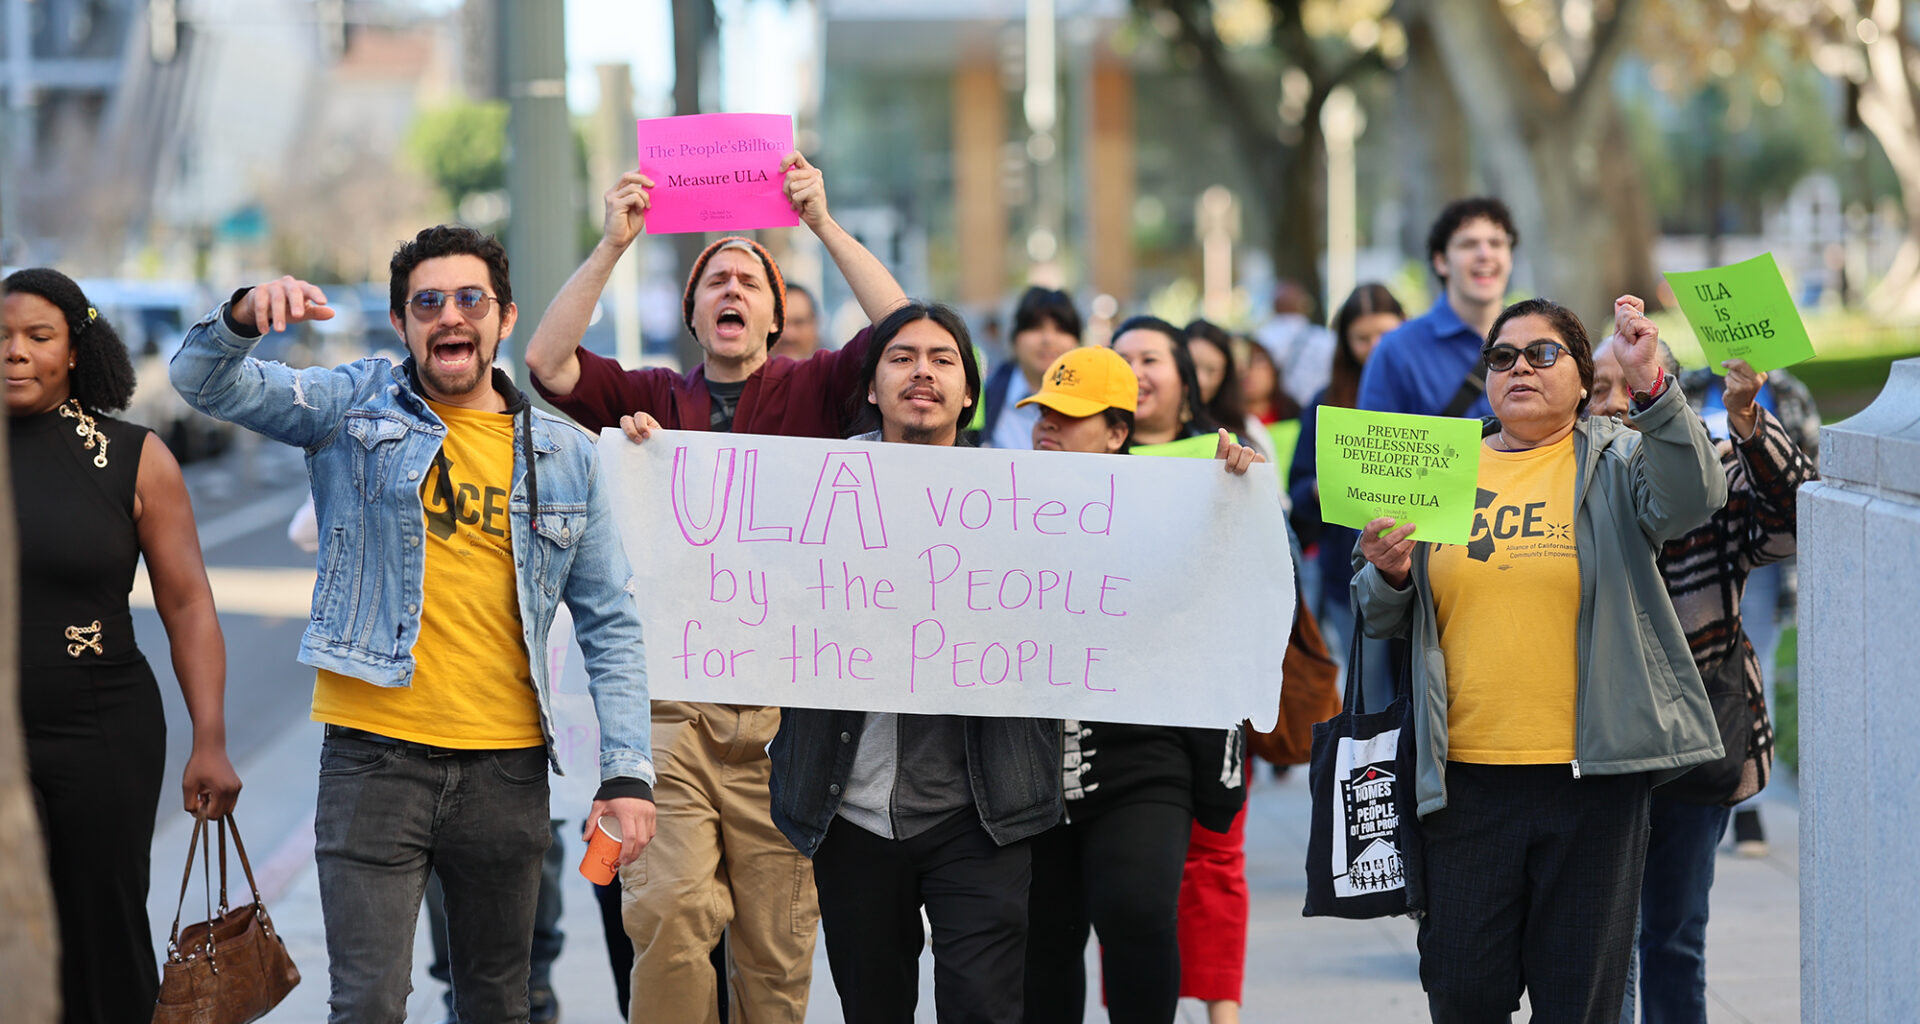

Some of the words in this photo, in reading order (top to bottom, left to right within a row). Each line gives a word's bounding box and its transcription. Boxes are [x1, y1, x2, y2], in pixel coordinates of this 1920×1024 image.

[646, 145, 675, 158] The
[668, 174, 730, 187] Measure
[734, 169, 768, 183] ULA
[1694, 282, 1732, 302] ULA
[1713, 304, 1730, 322] is
[1700, 318, 1775, 343] Working
[1367, 424, 1429, 441] PREVENT
[1335, 434, 1440, 455] HOMELESSNESS
[1342, 448, 1419, 466] DEVELOPER
[1423, 457, 1450, 468] TAX
[1361, 463, 1412, 478] BREAKS
[423, 465, 506, 538] CCE
[671, 446, 888, 550] ULA
[926, 461, 1115, 536] voted
[1346, 486, 1406, 505] Measure
[1409, 494, 1440, 508] ULA
[1435, 501, 1546, 552] CCE
[1510, 551, 1542, 559] Community
[709, 553, 768, 626] by
[806, 558, 898, 611] the
[918, 543, 1132, 616] PEOPLE
[672, 620, 756, 680] for
[779, 625, 875, 683] the
[911, 618, 1117, 693] PEOPLE
[1355, 782, 1392, 803] HOMES
[1357, 802, 1395, 823] PEOPLE
[1350, 824, 1359, 836] OT
[1361, 821, 1375, 834] FOR
